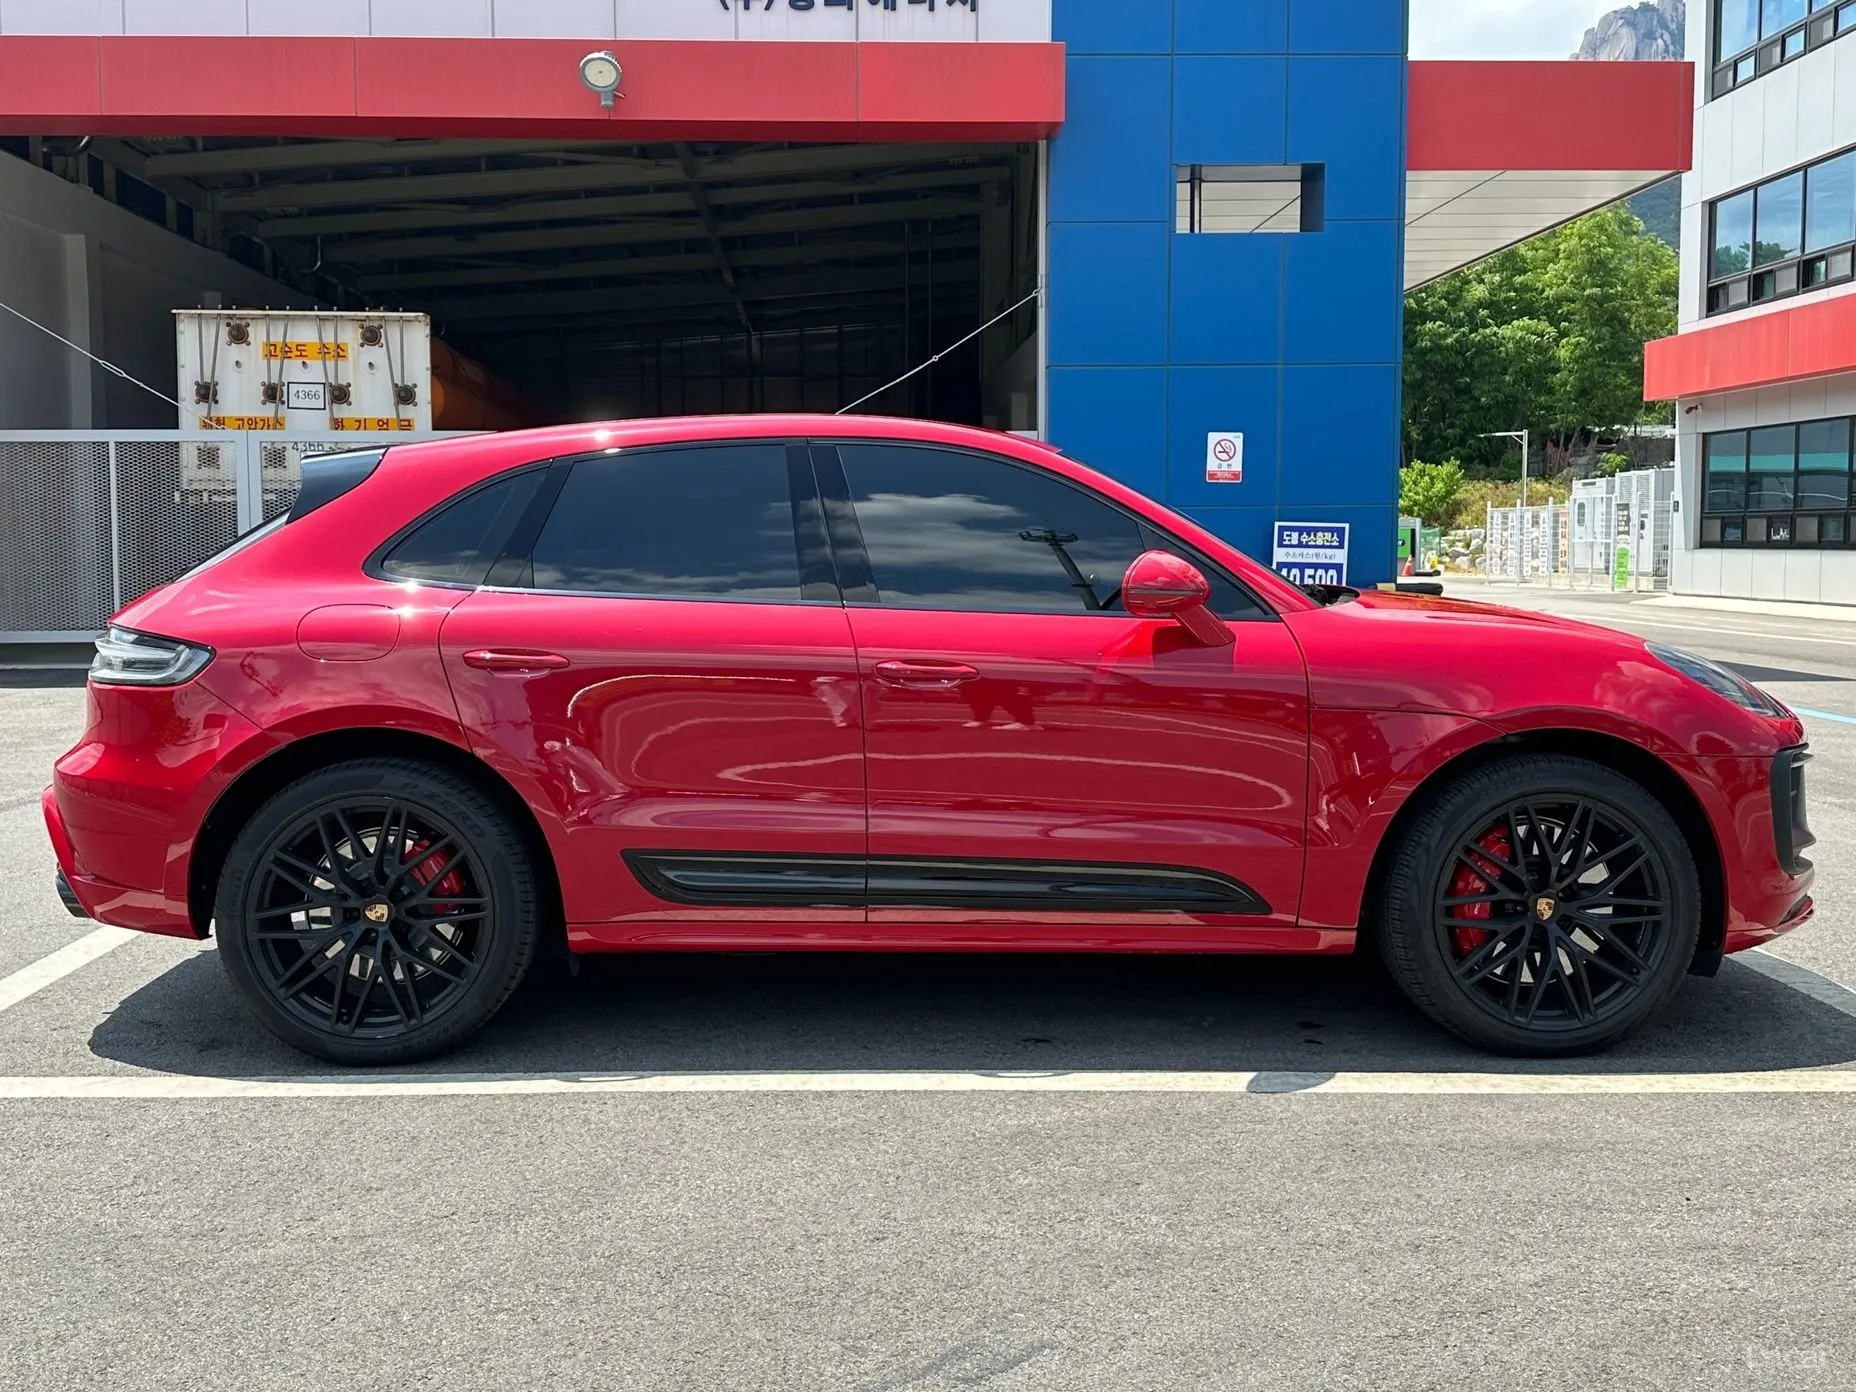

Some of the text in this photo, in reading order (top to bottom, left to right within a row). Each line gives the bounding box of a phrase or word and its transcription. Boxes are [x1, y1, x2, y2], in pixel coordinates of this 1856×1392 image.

[264, 343, 347, 359] 고순도 수소
[294, 389, 321, 400] 4366
[1282, 531, 1340, 546] 도봉 수소충전소
